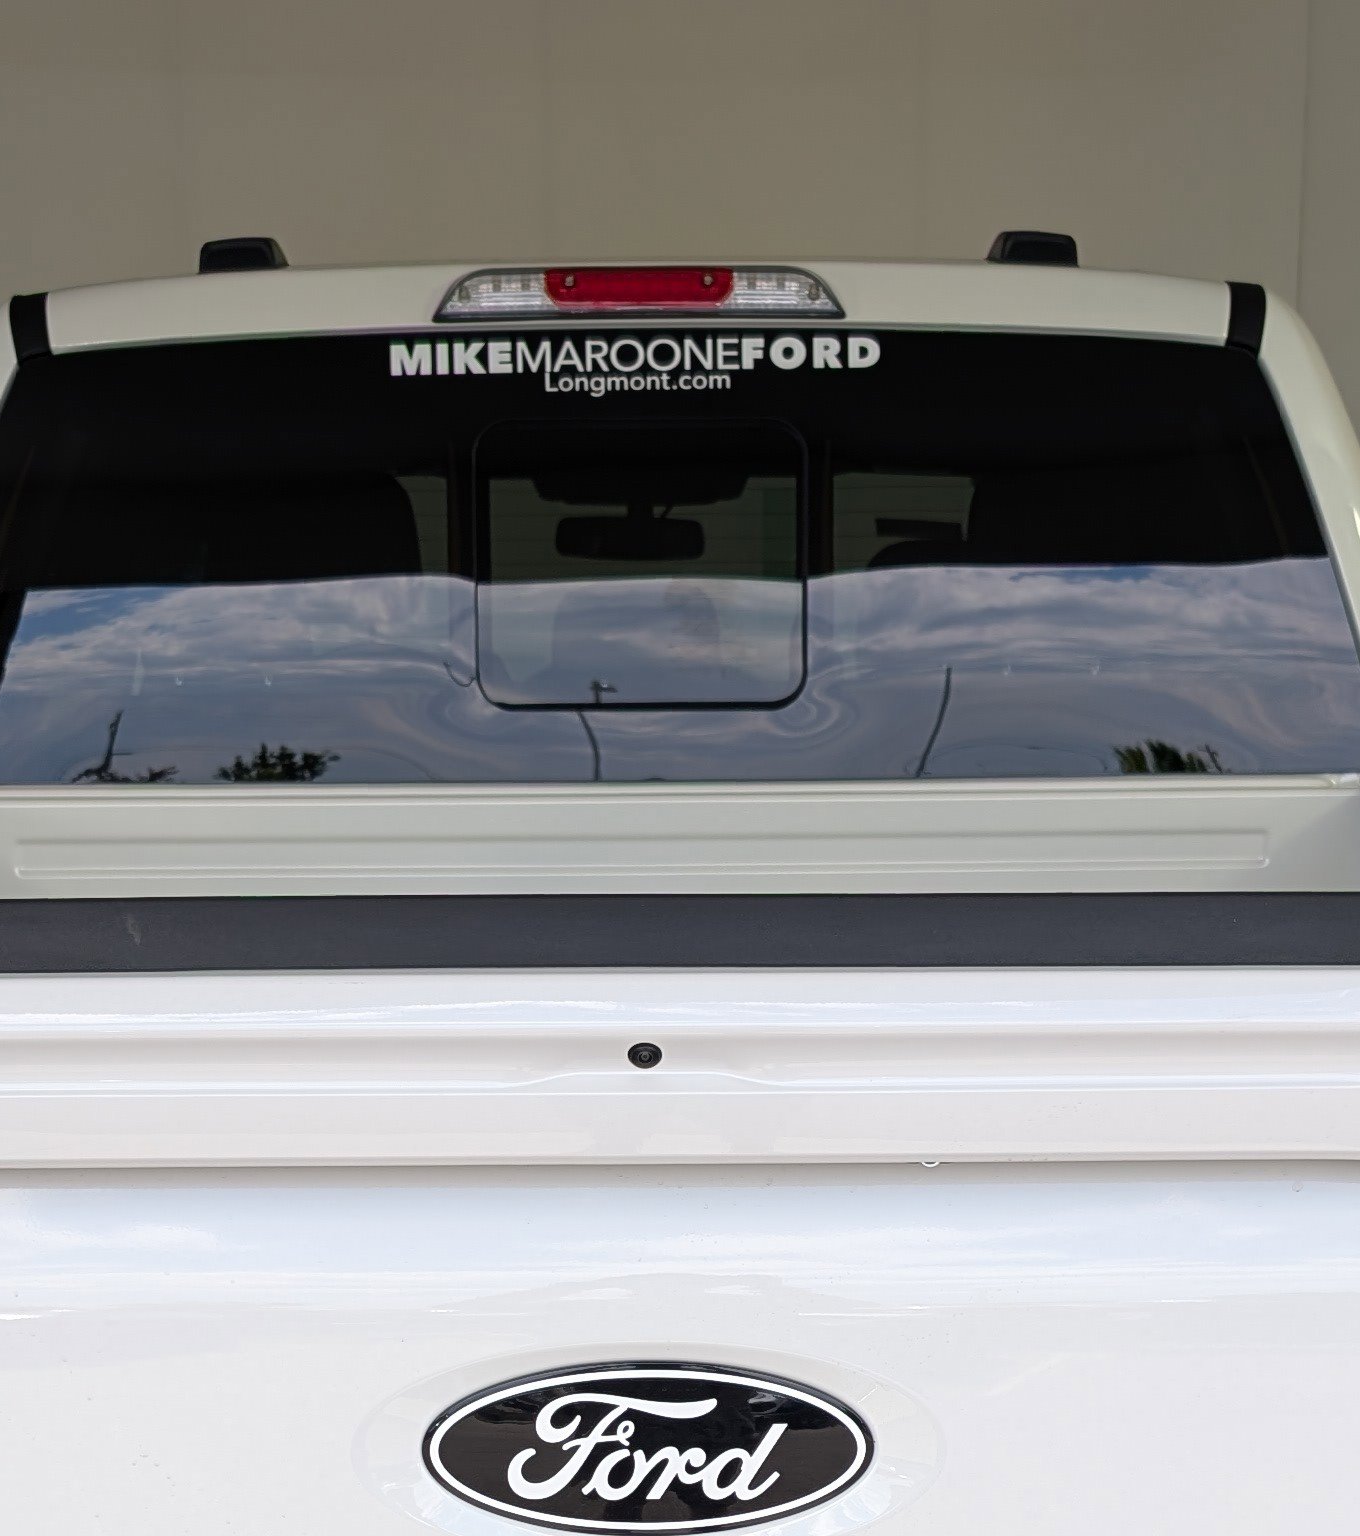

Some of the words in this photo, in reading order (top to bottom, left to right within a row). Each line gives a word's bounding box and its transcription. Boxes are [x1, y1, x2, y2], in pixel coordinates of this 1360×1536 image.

[389, 335, 882, 376] MIKEMAROONEFORD
[545, 372, 731, 397] Longmont.com
[507, 1392, 789, 1501] Ford
